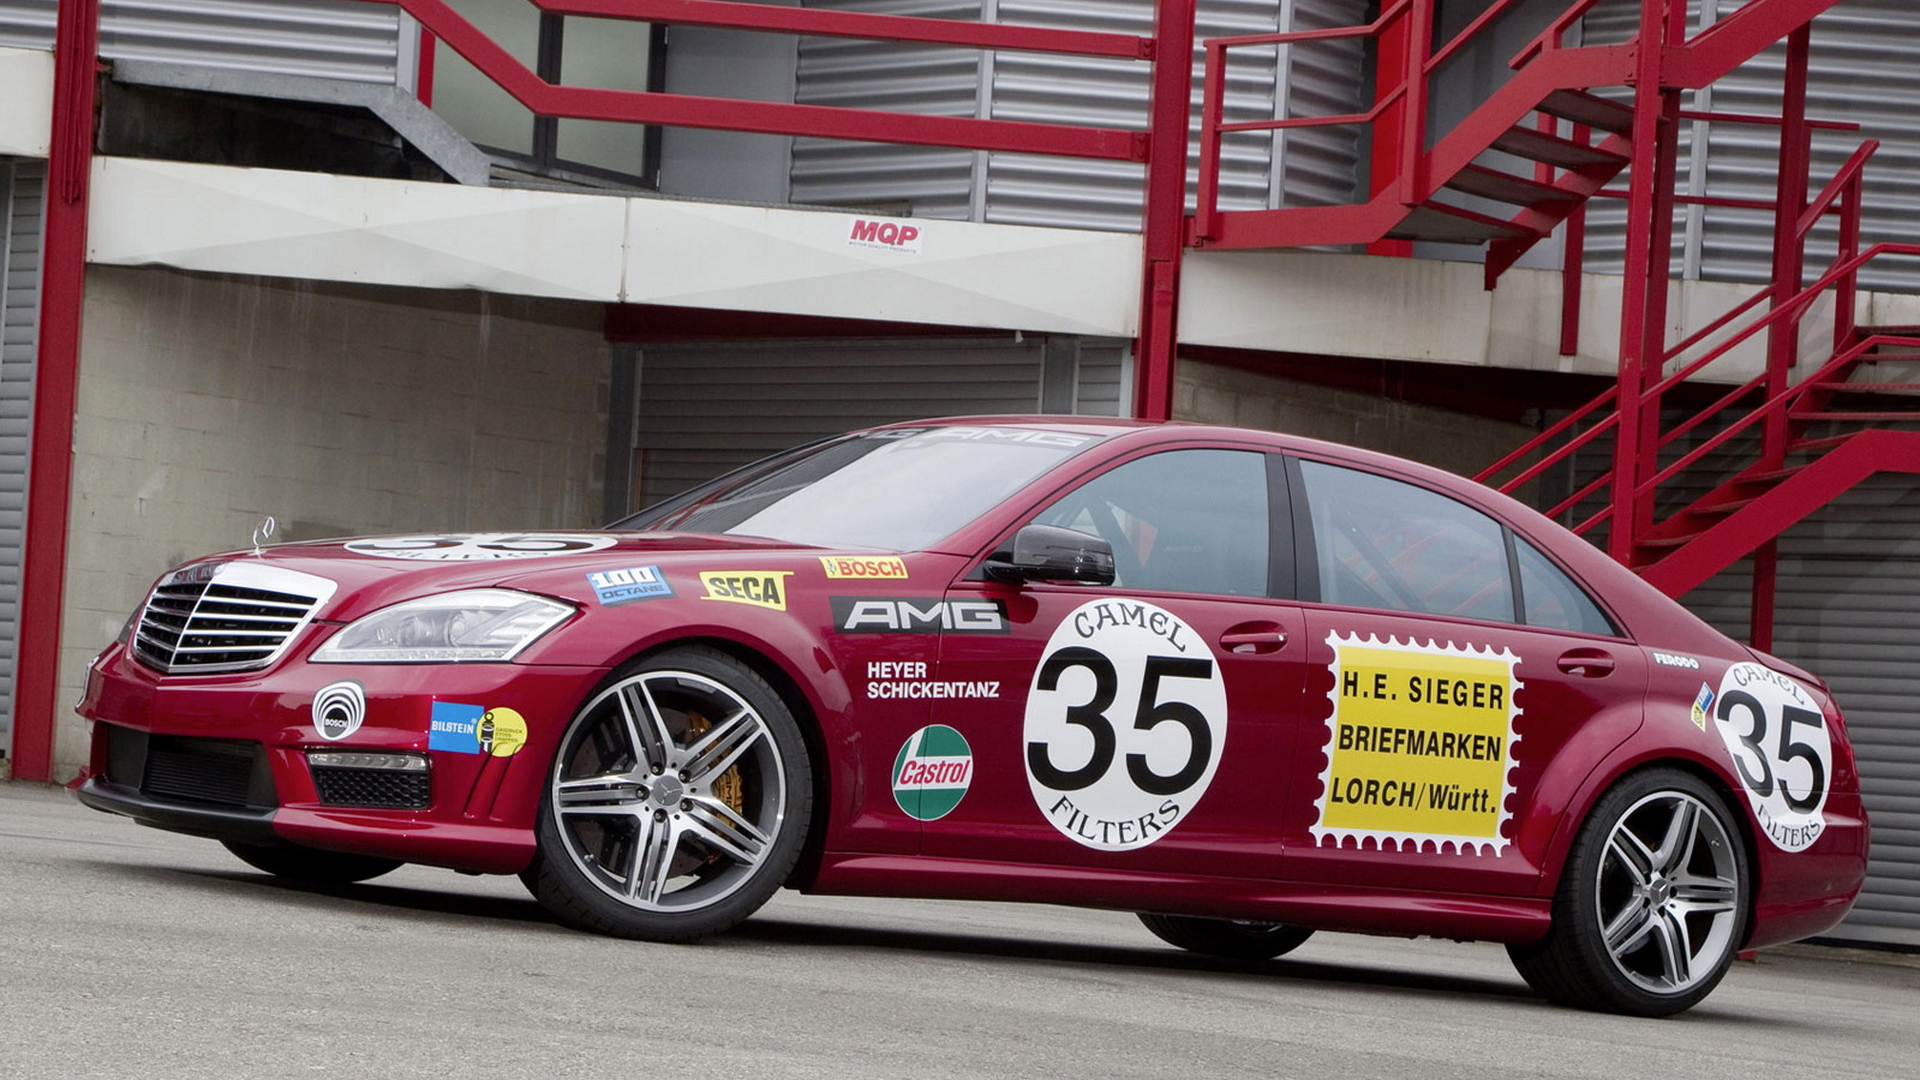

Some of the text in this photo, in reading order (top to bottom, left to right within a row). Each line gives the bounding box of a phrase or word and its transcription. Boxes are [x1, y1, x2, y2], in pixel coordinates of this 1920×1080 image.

[850, 220, 918, 246] MQP
[591, 567, 658, 588] 100
[838, 560, 905, 576] BOSCH
[602, 585, 665, 599] OCTANE
[709, 577, 781, 604] SECA
[844, 601, 1002, 630] AMG
[1074, 603, 1186, 652] CAMEL
[867, 661, 927, 679] HEYER
[1653, 653, 1700, 670] FERODO
[867, 681, 1000, 699] SCHICKENTANZ
[1343, 670, 1504, 710] H.E. SIEGER
[1733, 665, 1805, 705] CAMEL
[324, 718, 349, 728] BOSCH
[431, 721, 474, 734] BILSTEIN
[1027, 646, 1213, 796] 35
[1338, 724, 1502, 762] BRIEFMARKEN
[1717, 690, 1825, 815] 35
[899, 759, 971, 784] Castrol
[1331, 776, 1497, 814] LORCH/Württ.
[1050, 795, 1180, 844] FILTERS
[1758, 803, 1821, 847] FILTERS
